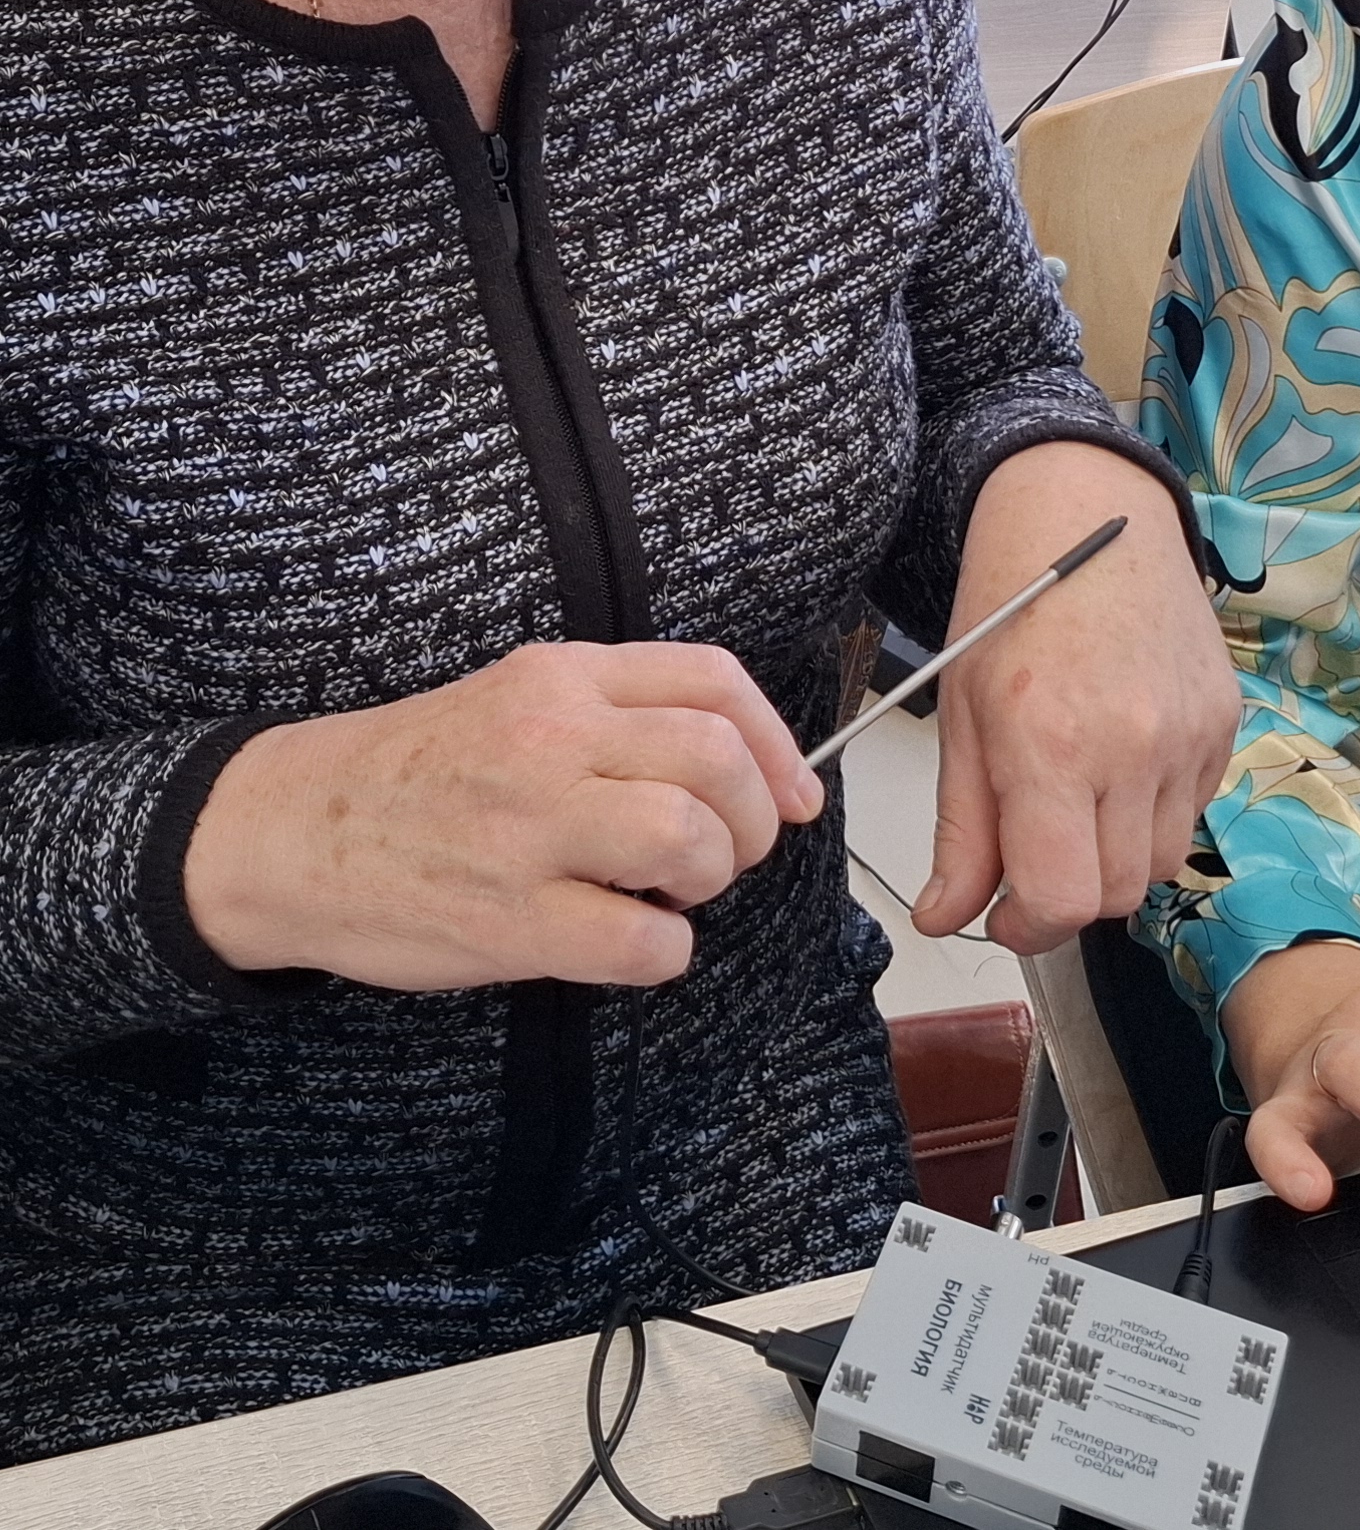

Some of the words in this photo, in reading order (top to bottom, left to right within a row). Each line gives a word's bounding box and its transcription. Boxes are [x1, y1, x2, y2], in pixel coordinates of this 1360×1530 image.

[911, 1278, 963, 1377] БИОЛОГИЯ
[941, 1284, 993, 1395] мультидатчик
[1092, 1320, 1190, 1361] окружающей
[1120, 1319, 1167, 1343] среды
[1087, 1329, 1186, 1375] Температура
[1106, 1368, 1202, 1408] Влажность
[1050, 1433, 1156, 1478] исследуемой
[1057, 1420, 1158, 1467] Температура
[1075, 1454, 1125, 1479] среды
